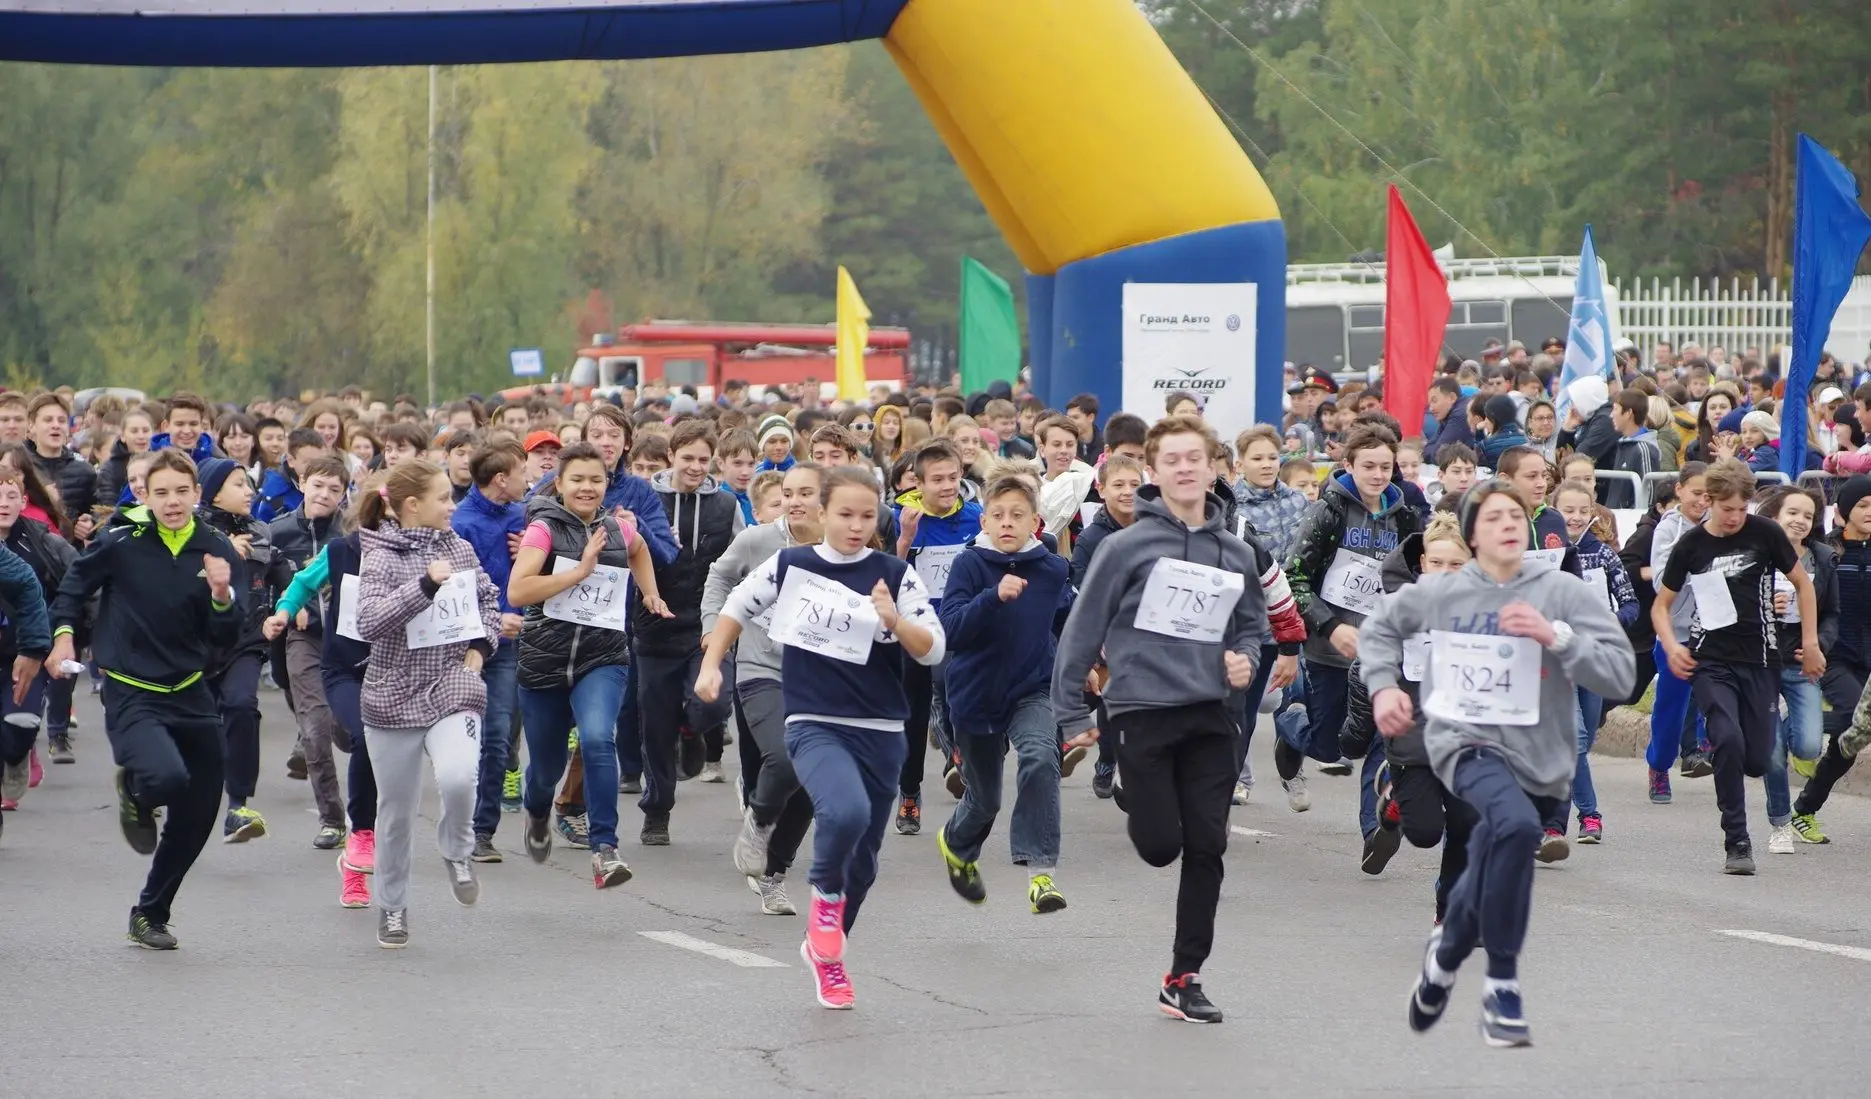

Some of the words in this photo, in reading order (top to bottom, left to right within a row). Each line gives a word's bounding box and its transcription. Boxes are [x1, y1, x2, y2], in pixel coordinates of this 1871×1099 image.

[1140, 313, 1178, 325] Гранд
[1182, 313, 1211, 323] Авто
[1153, 379, 1227, 389] RECORD
[1343, 526, 1372, 549] IGH
[1374, 528, 1399, 550] JUM
[930, 563, 951, 581] 78
[568, 583, 614, 607] 7814
[1165, 585, 1221, 616] 7787
[796, 597, 852, 633] 7813
[1449, 663, 1512, 693] 7824
